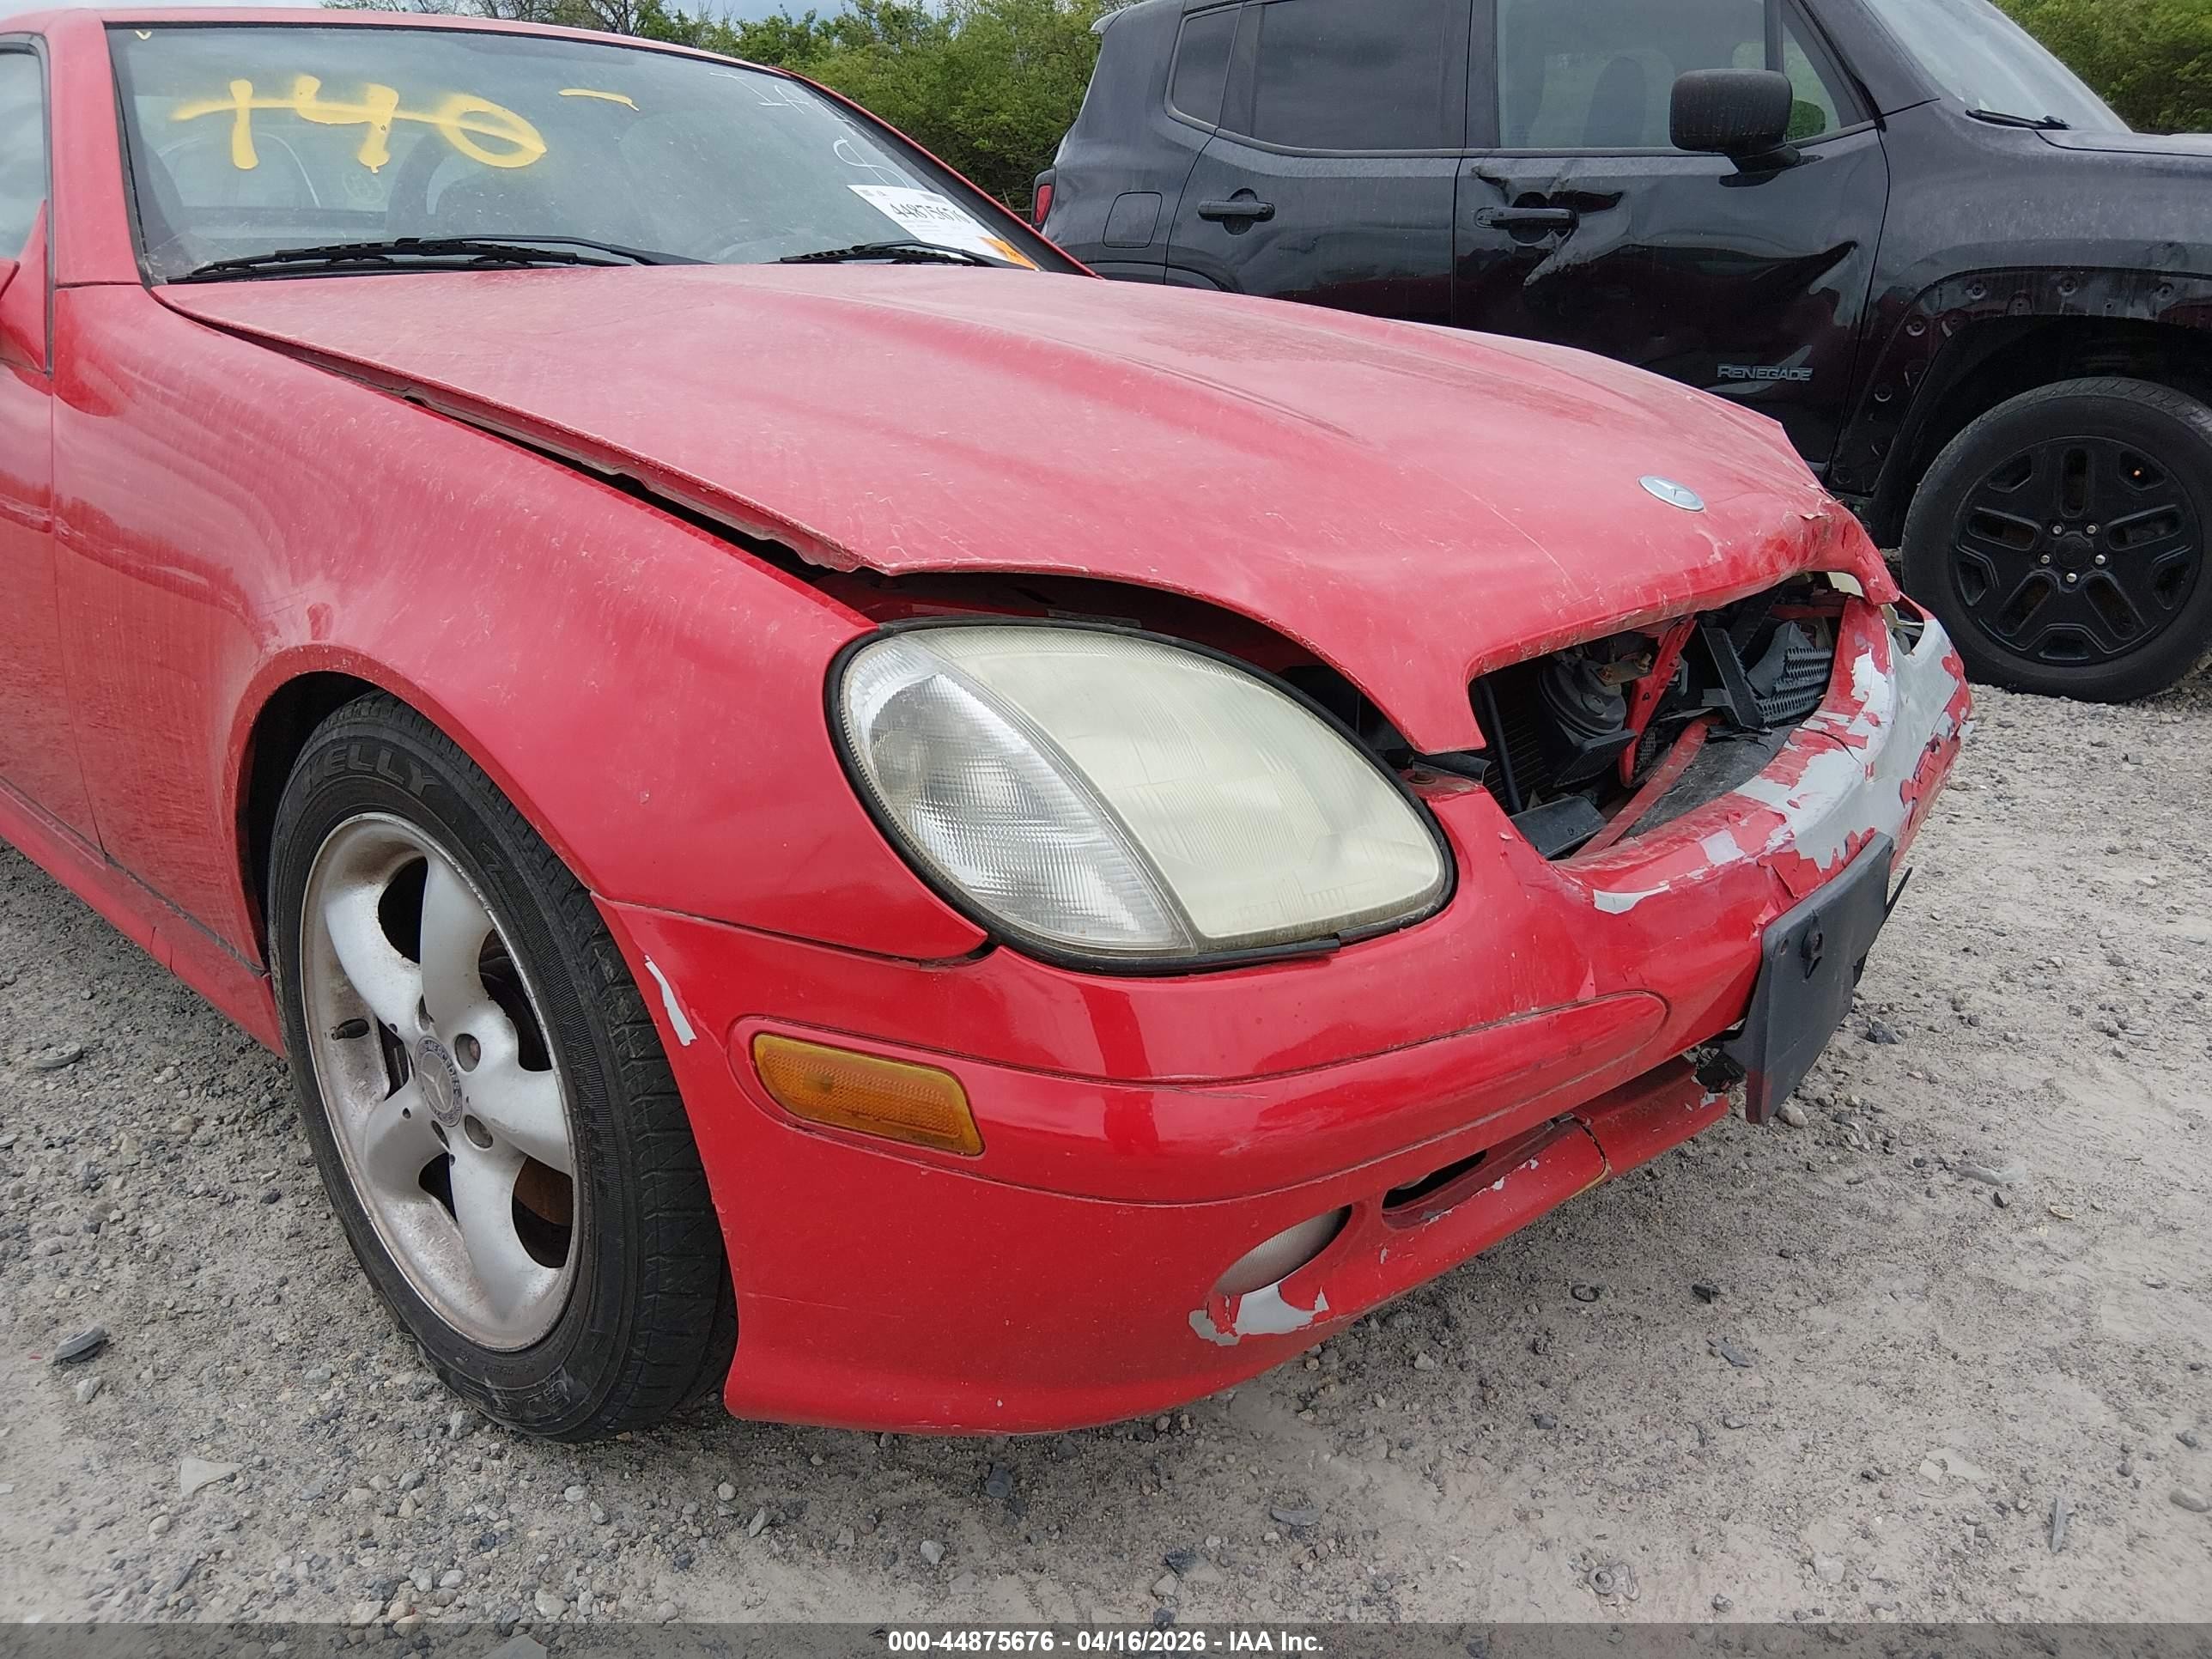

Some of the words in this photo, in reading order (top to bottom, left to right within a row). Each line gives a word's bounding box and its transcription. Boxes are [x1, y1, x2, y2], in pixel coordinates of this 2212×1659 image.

[889, 203, 970, 224] 44875676
[1717, 363, 1814, 381] RENEGADE
[301, 742, 443, 798] KELLY
